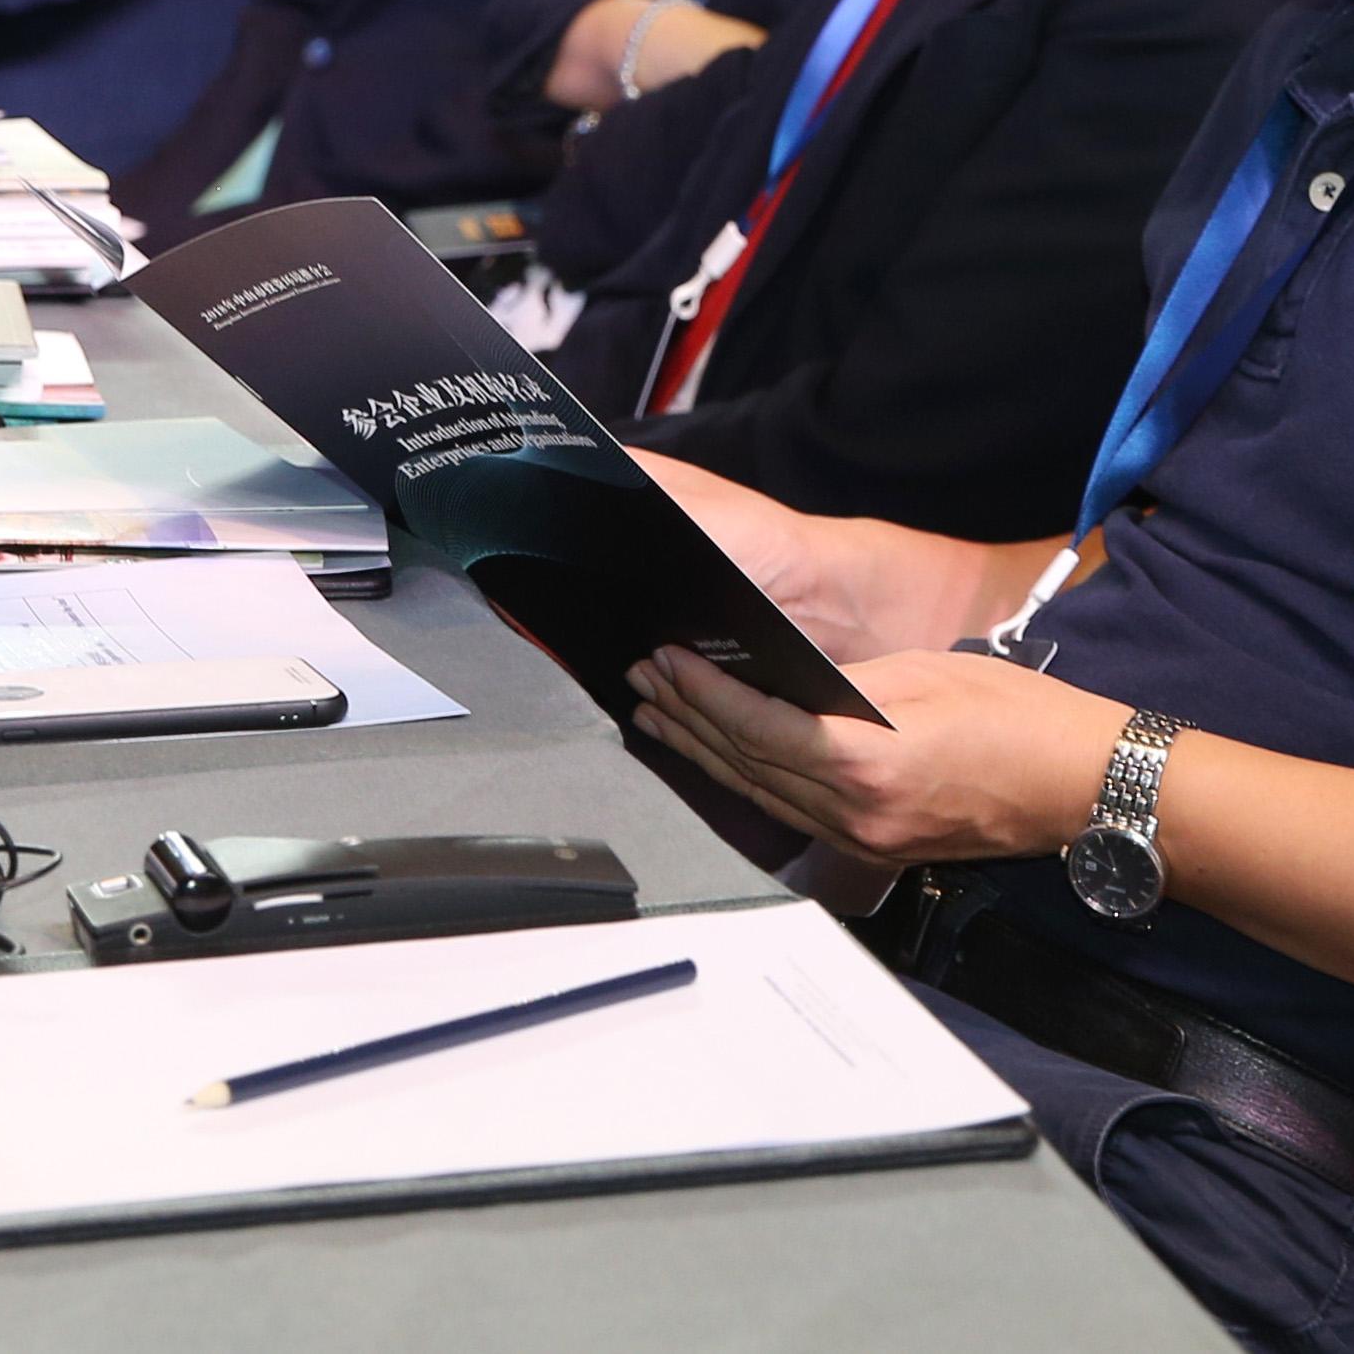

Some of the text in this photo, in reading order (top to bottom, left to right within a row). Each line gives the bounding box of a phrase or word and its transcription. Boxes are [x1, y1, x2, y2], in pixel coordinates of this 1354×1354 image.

[342, 372, 552, 440] 参会企业及机构名录
[397, 416, 491, 453] Introduction
[398, 440, 491, 480] Enterprises
[487, 432, 516, 453] and
